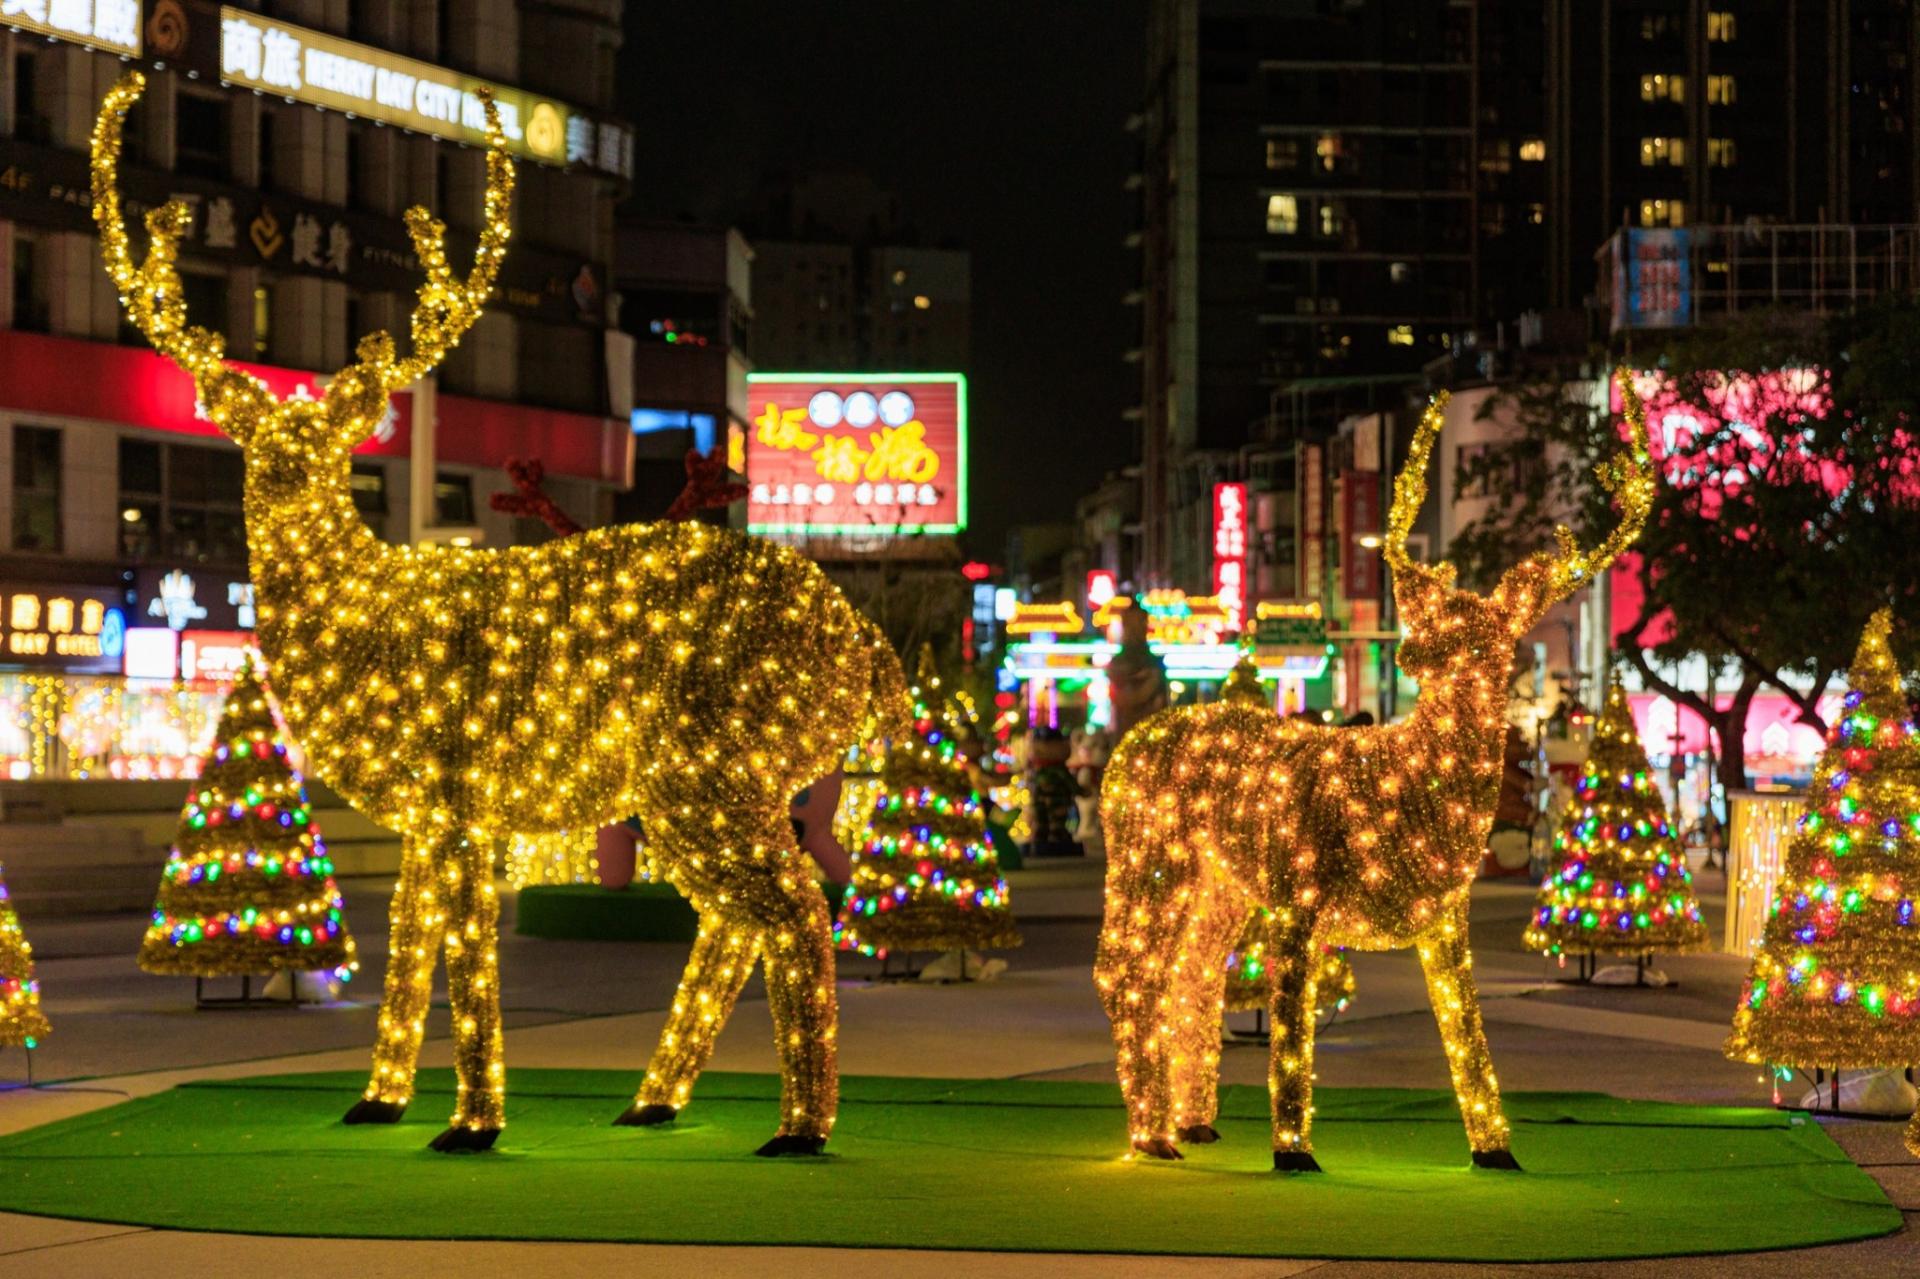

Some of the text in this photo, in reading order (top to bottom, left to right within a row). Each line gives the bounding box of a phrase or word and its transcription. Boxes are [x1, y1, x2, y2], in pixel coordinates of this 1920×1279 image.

[222, 19, 302, 91] 商旅
[304, 47, 376, 101] MERRY
[415, 79, 462, 124] CITY
[461, 91, 523, 141] HOEL
